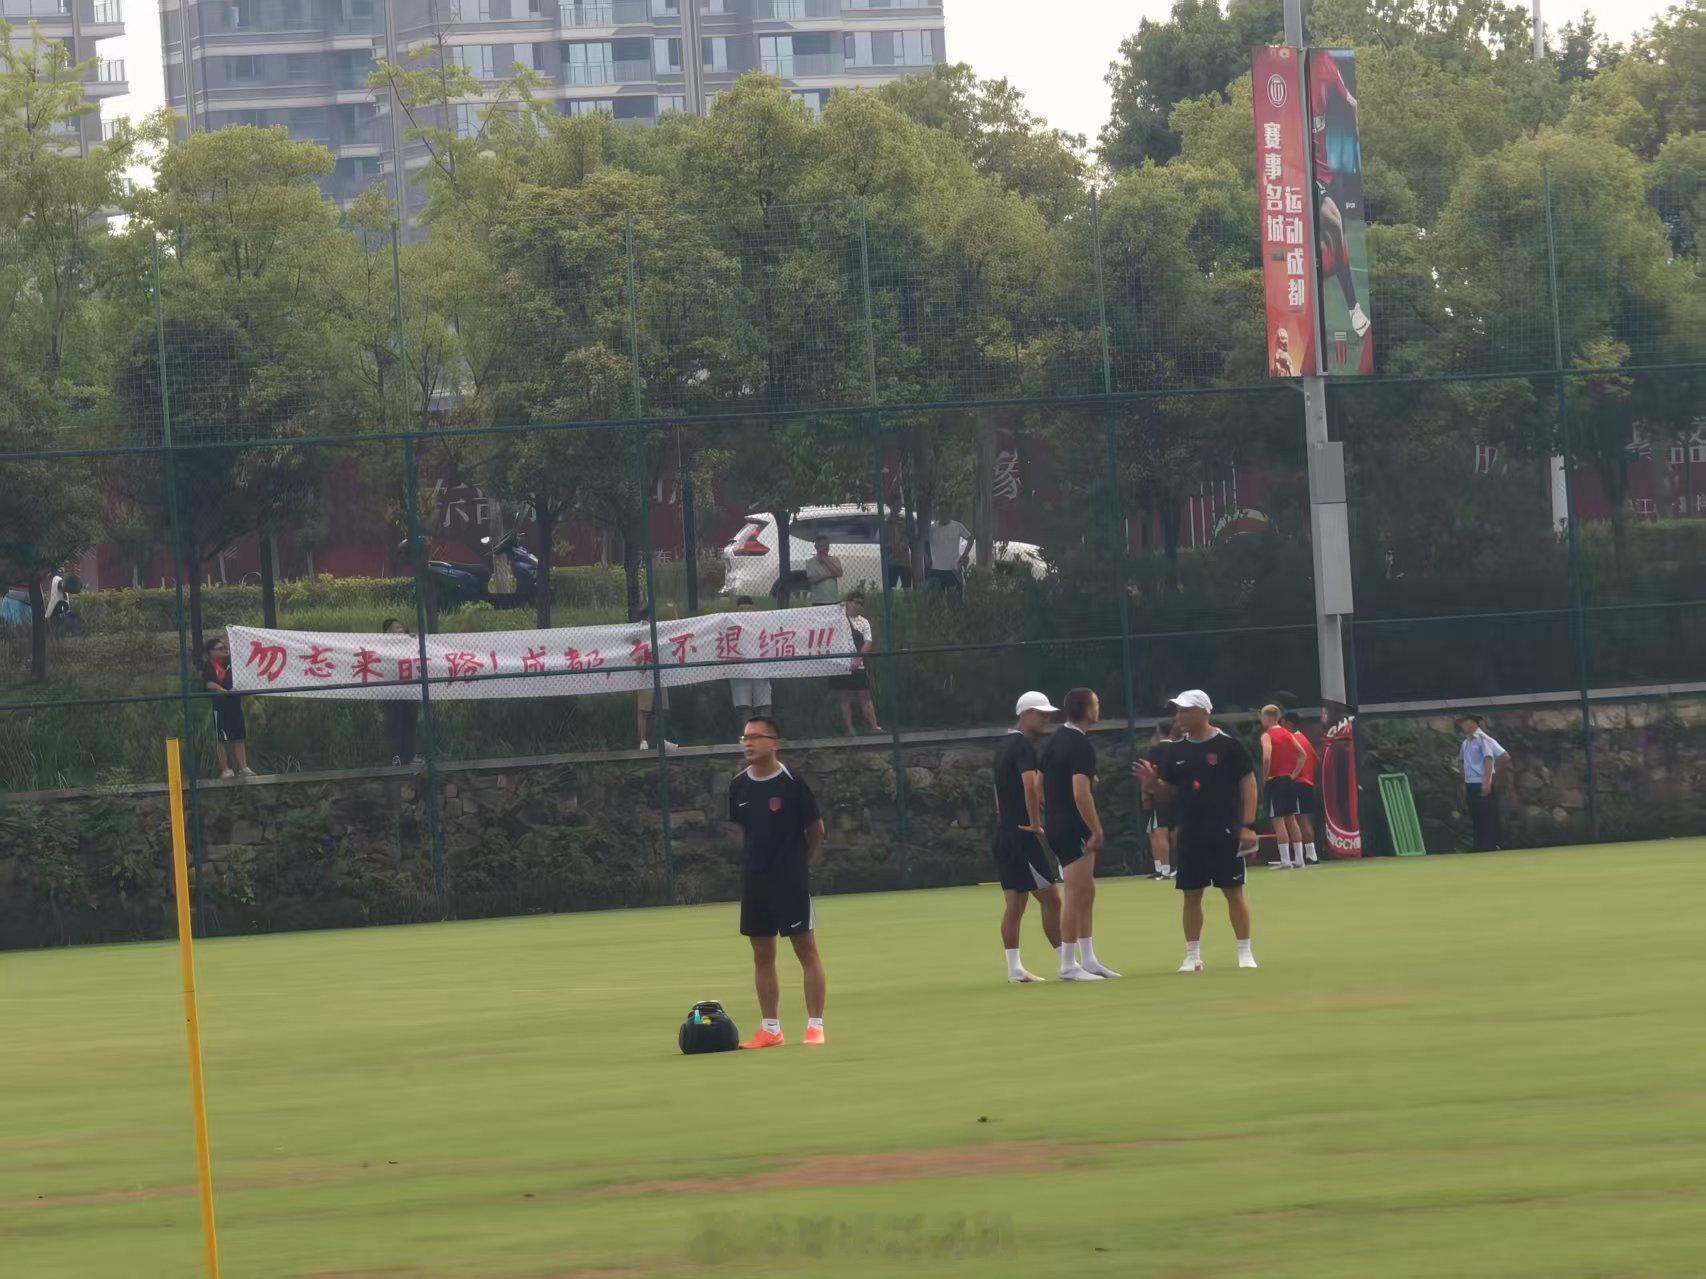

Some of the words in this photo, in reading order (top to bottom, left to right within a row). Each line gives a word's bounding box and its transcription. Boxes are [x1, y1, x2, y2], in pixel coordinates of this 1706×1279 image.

[1263, 121, 1285, 243] 赛事名城
[1284, 185, 1305, 306] 运动成都
